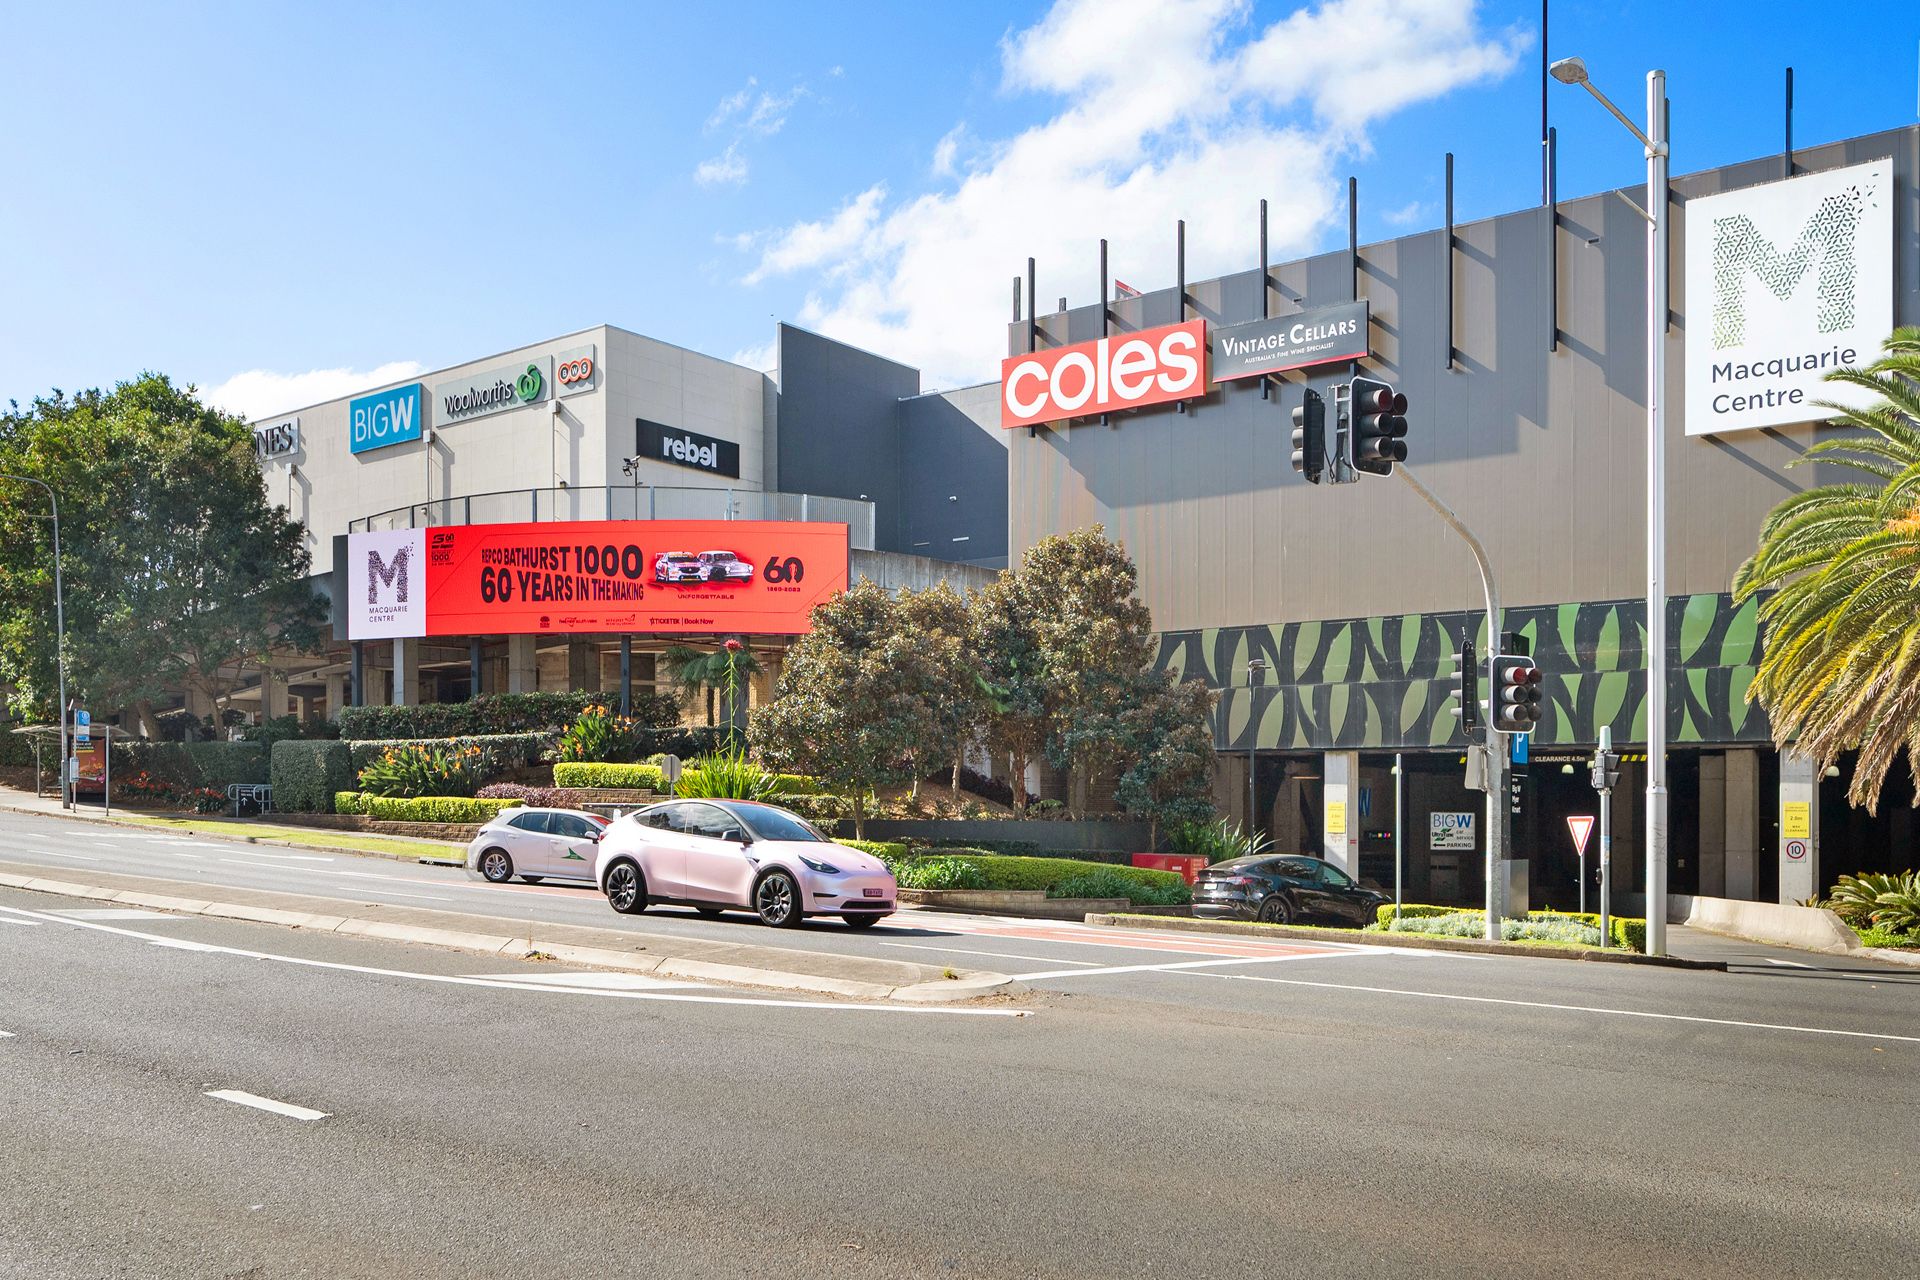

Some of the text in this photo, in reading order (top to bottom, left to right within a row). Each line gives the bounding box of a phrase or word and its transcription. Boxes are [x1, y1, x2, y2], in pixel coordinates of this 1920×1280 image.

[560, 362, 588, 379] BWS
[1005, 331, 1198, 418] coles
[1711, 346, 1857, 383] Macquarie
[1712, 388, 1804, 414] Centre
[663, 435, 717, 468] rebel
[504, 546, 571, 573] BATHURST
[574, 544, 644, 580] 1000
[763, 556, 804, 584] 60
[480, 566, 644, 604] 60 YEARS IN THE MAKING
[368, 605, 408, 614] MACQUARIE
[368, 615, 394, 623] CENTRE
[1790, 845, 1801, 855] 10
